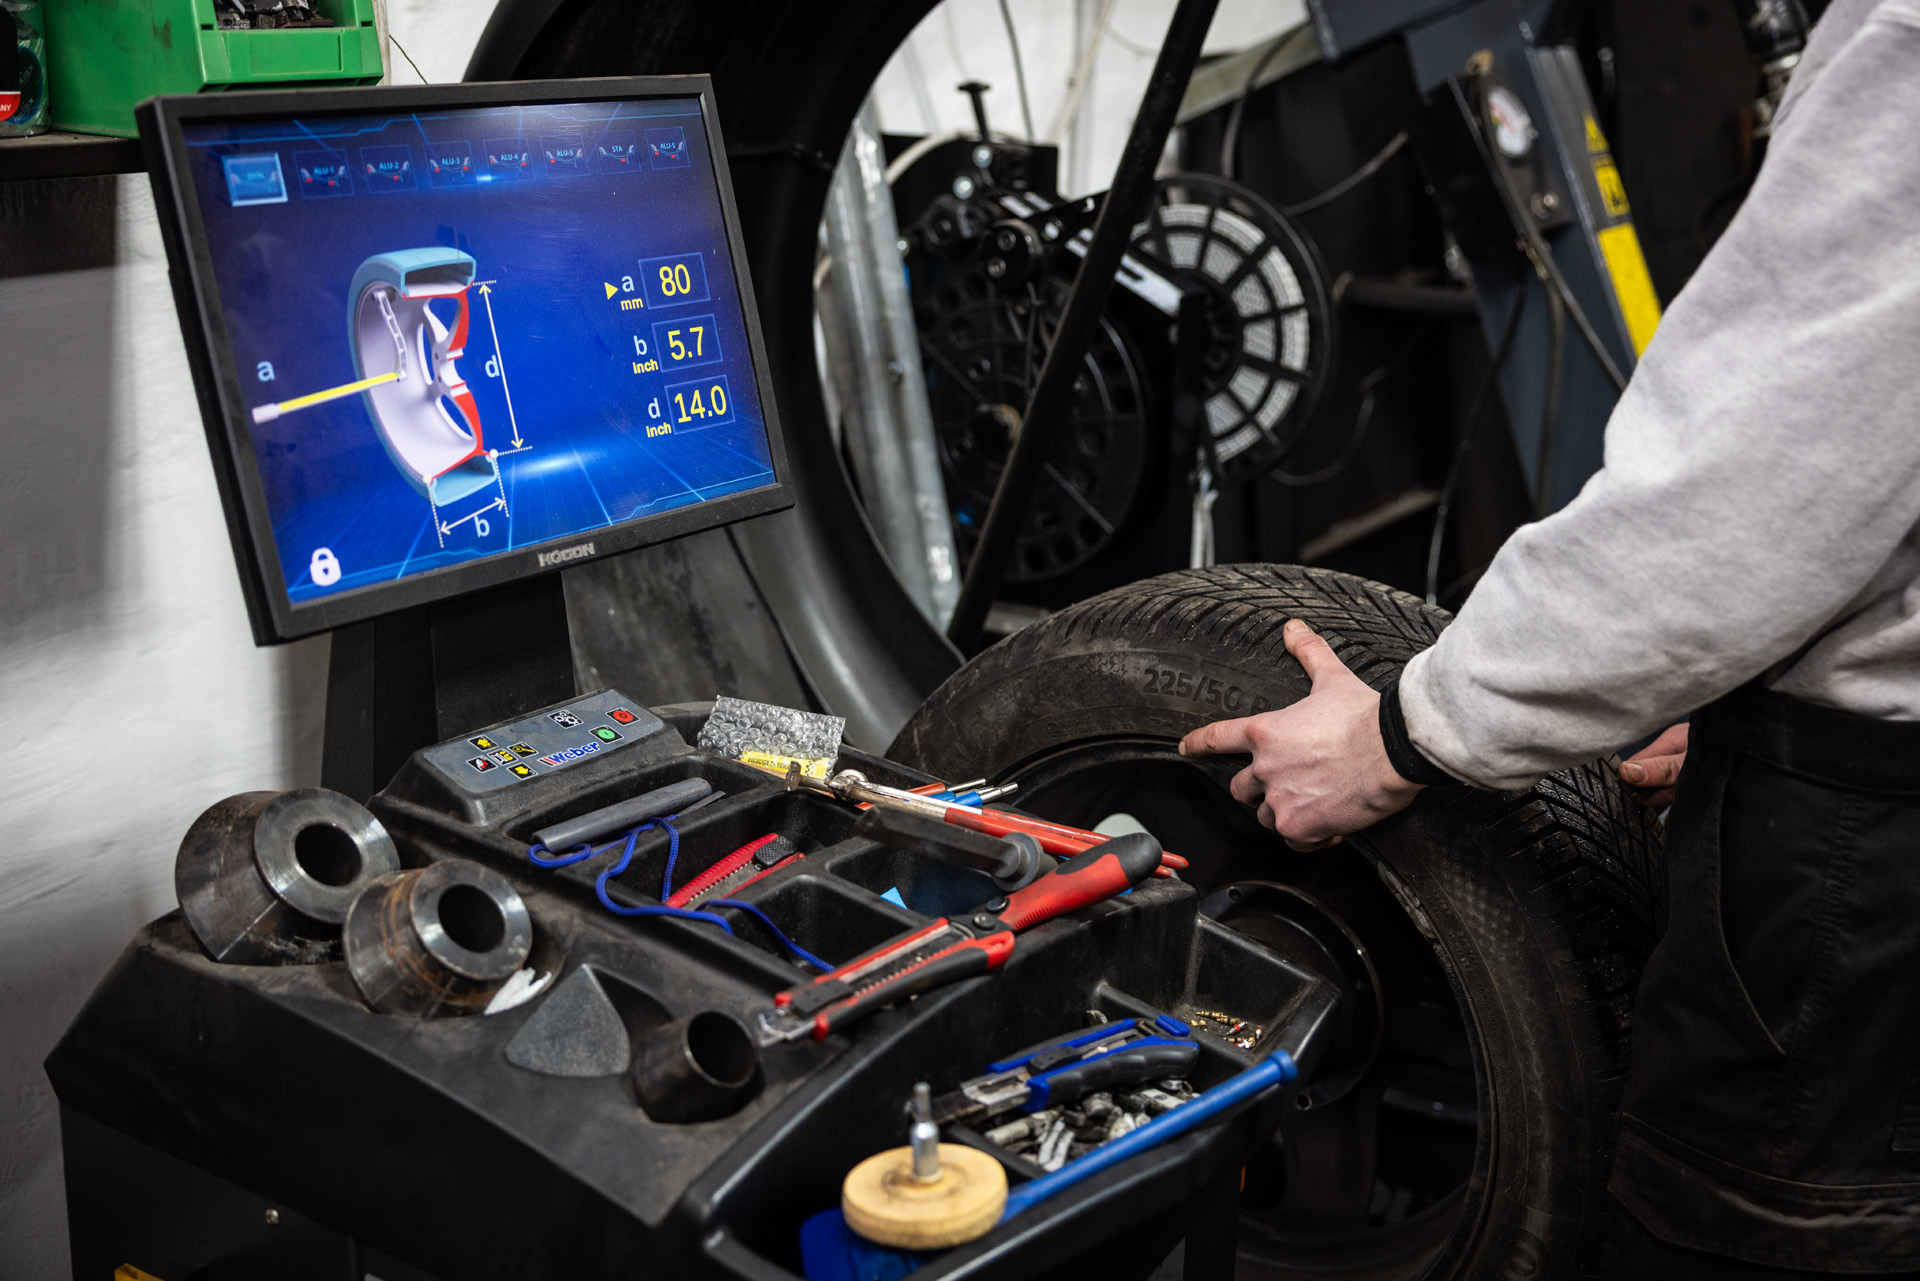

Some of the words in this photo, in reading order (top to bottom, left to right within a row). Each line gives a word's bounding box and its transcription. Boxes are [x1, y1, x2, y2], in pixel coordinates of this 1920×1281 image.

[500, 153, 519, 161] ALU-4
[611, 145, 624, 153] STA
[314, 165, 335, 175] ALU-1
[379, 162, 399, 170] ALU-2
[441, 157, 461, 166] ALU-3
[621, 275, 635, 292] a
[659, 264, 691, 296] 80
[620, 298, 644, 311] mm
[633, 335, 648, 356] b
[667, 326, 704, 360] 5.7
[257, 361, 276, 381] a
[485, 355, 501, 378] d
[632, 359, 659, 374] inch
[648, 397, 661, 419] d
[674, 385, 727, 423] 14.0
[646, 422, 672, 438] inch
[473, 515, 491, 537] b
[1142, 668, 1245, 712] 225/50
[548, 742, 600, 763] Weber
